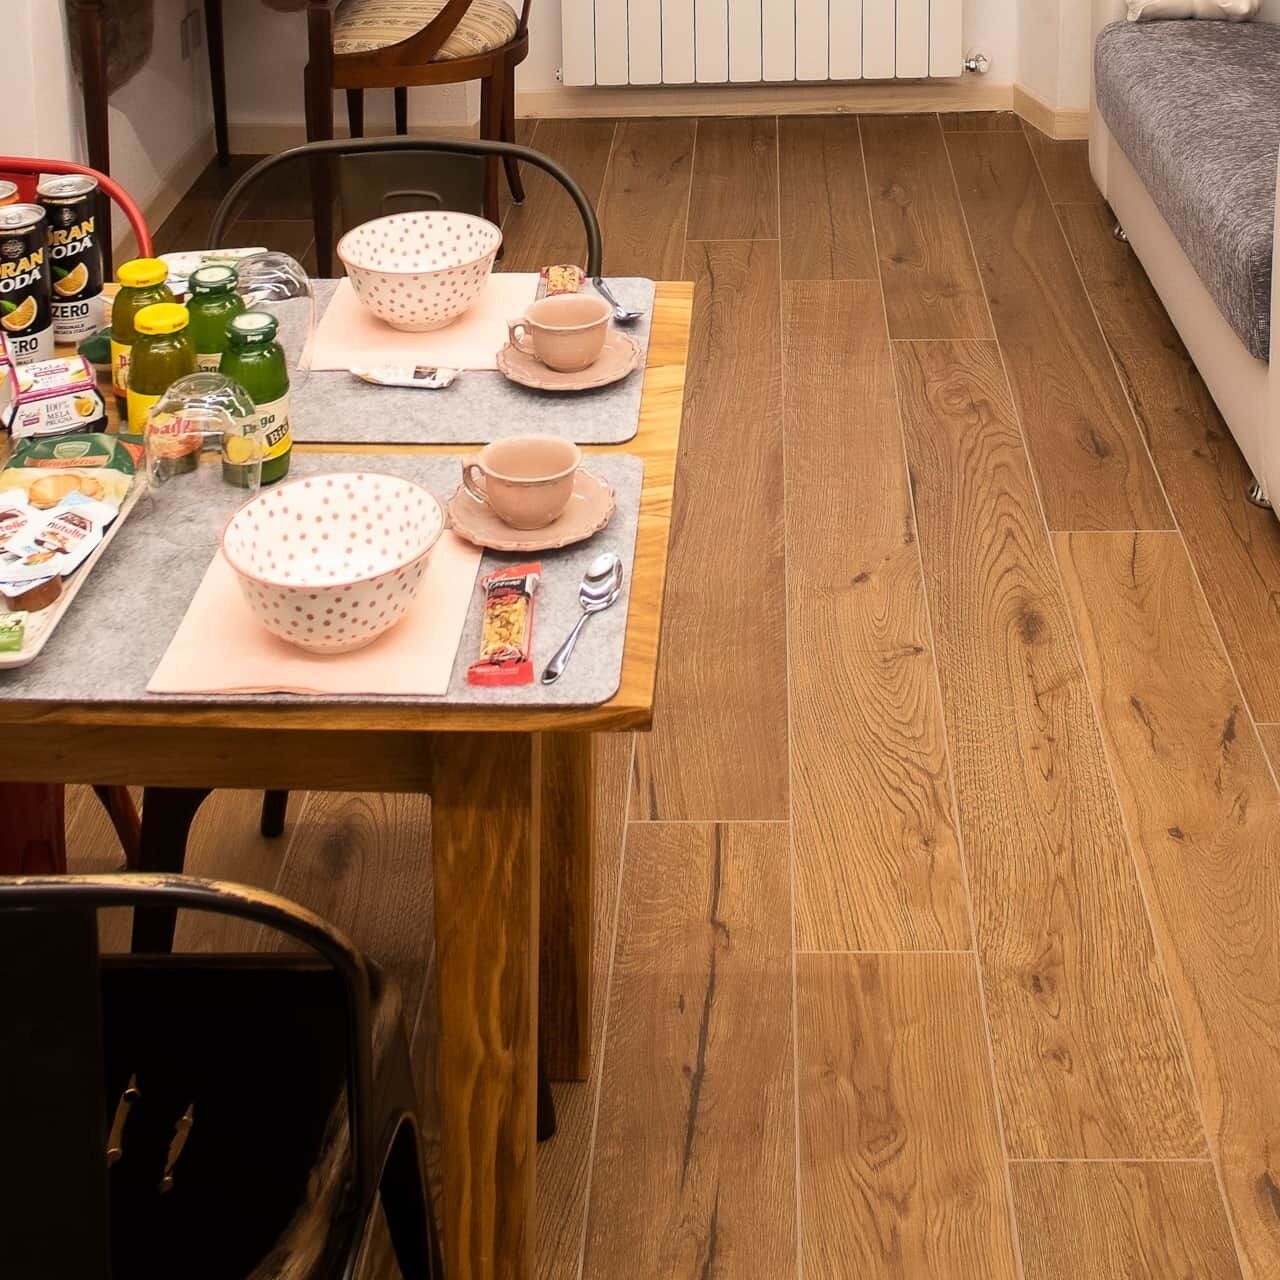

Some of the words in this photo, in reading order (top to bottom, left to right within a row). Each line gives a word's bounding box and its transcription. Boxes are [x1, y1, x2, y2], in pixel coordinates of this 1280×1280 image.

[48, 216, 95, 246] RAN
[49, 233, 94, 260] ODA
[51, 303, 89, 318] ZERO
[13, 337, 39, 355] ERO
[47, 409, 71, 420] MELA
[47, 521, 87, 540] nutella
